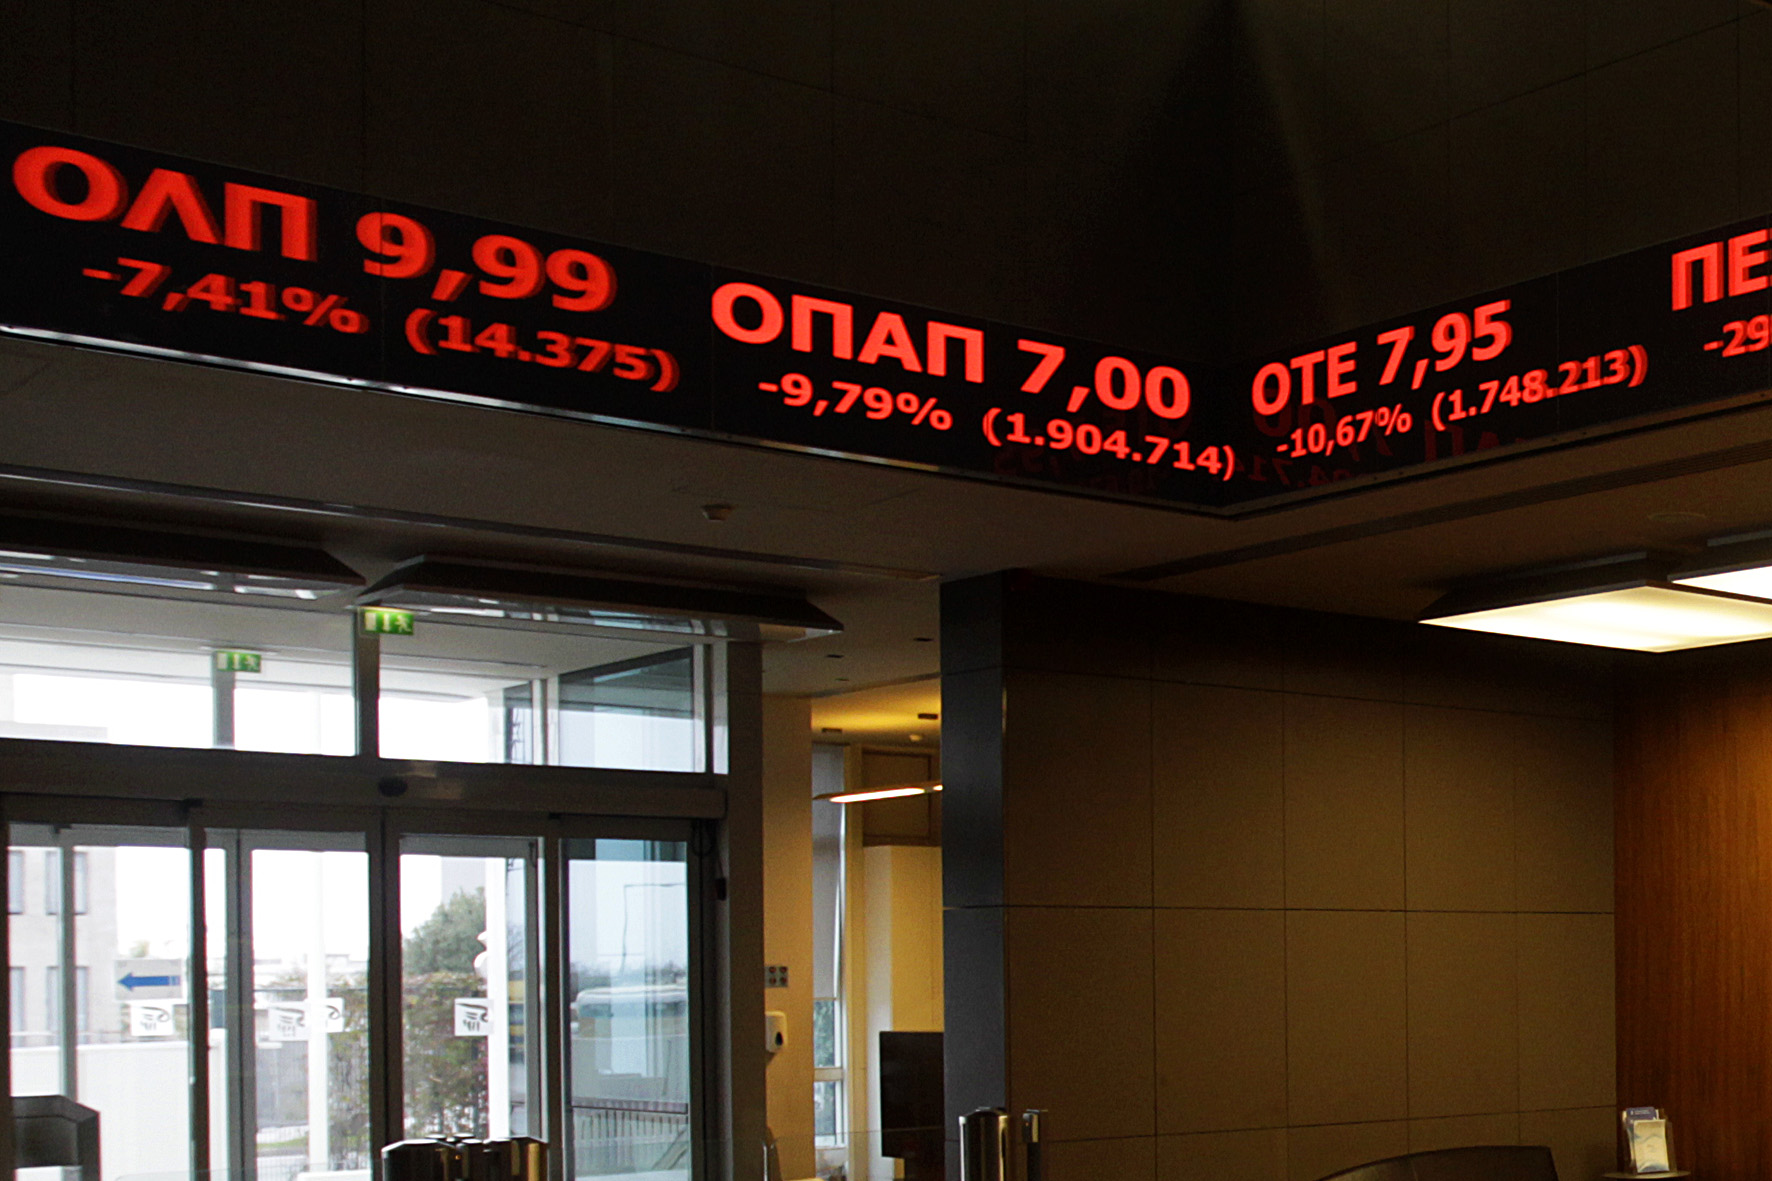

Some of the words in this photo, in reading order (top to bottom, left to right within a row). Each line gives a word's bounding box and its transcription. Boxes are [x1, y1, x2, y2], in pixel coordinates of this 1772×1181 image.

[12, 146, 317, 261] ΟΛΠ
[355, 211, 617, 311] 9,99
[82, 257, 369, 334] -7,41%
[404, 308, 680, 392] (14.375)
[711, 282, 985, 384] ΟΠΑΠ
[1017, 338, 1191, 420] 7,00
[1251, 340, 1358, 416] ΟΤΕ
[1376, 299, 1513, 391] 7,95
[758, 372, 954, 431] -9,79%
[982, 407, 1236, 482] (1.904.714)
[1276, 403, 1413, 458] -10,67%
[1431, 344, 1648, 432] (1.748.213)
